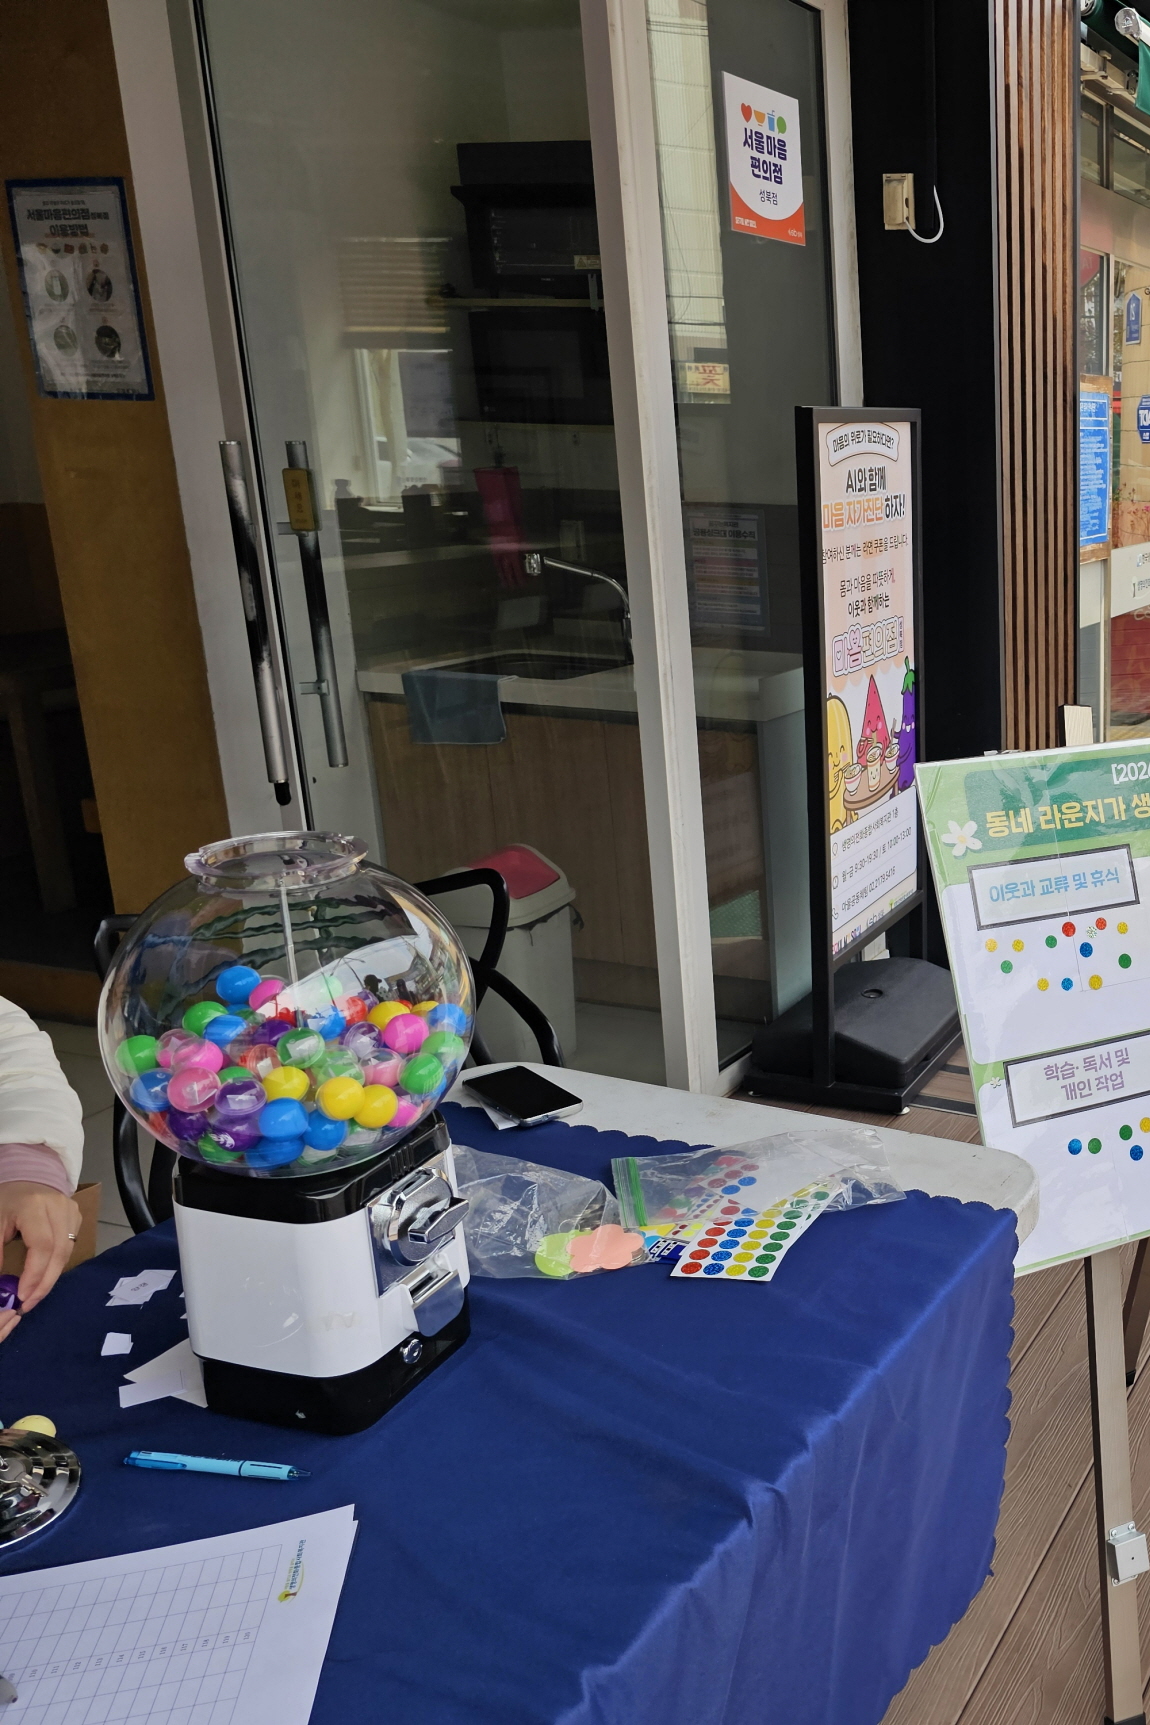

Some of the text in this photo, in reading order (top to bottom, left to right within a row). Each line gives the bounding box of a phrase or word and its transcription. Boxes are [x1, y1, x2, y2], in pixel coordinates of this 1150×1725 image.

[743, 127, 787, 161] 서울 마음
[750, 156, 783, 185] 편의점
[759, 189, 778, 205] 성북점
[833, 429, 894, 452] 마음의 위로가 필요하다면?
[846, 466, 887, 493] AI와 함께
[822, 494, 906, 528] 마음 자가진단 하자!
[862, 540, 873, 555] 라면
[874, 536, 888, 552] 쿠폰을
[840, 577, 853, 598] 몸과
[854, 573, 872, 593] 마음을
[848, 592, 890, 617] 이웃과 함께하는
[833, 618, 899, 675] 마음편의점
[985, 808, 1034, 838] 동네
[1038, 796, 1126, 831] 라운지가
[841, 866, 854, 883] 월-금
[989, 867, 1120, 903] 이웃과 교류 및 휴식
[1083, 1053, 1113, 1075] 독서
[1114, 1047, 1131, 1066] 및
[1061, 1071, 1126, 1101] 개인 작업
